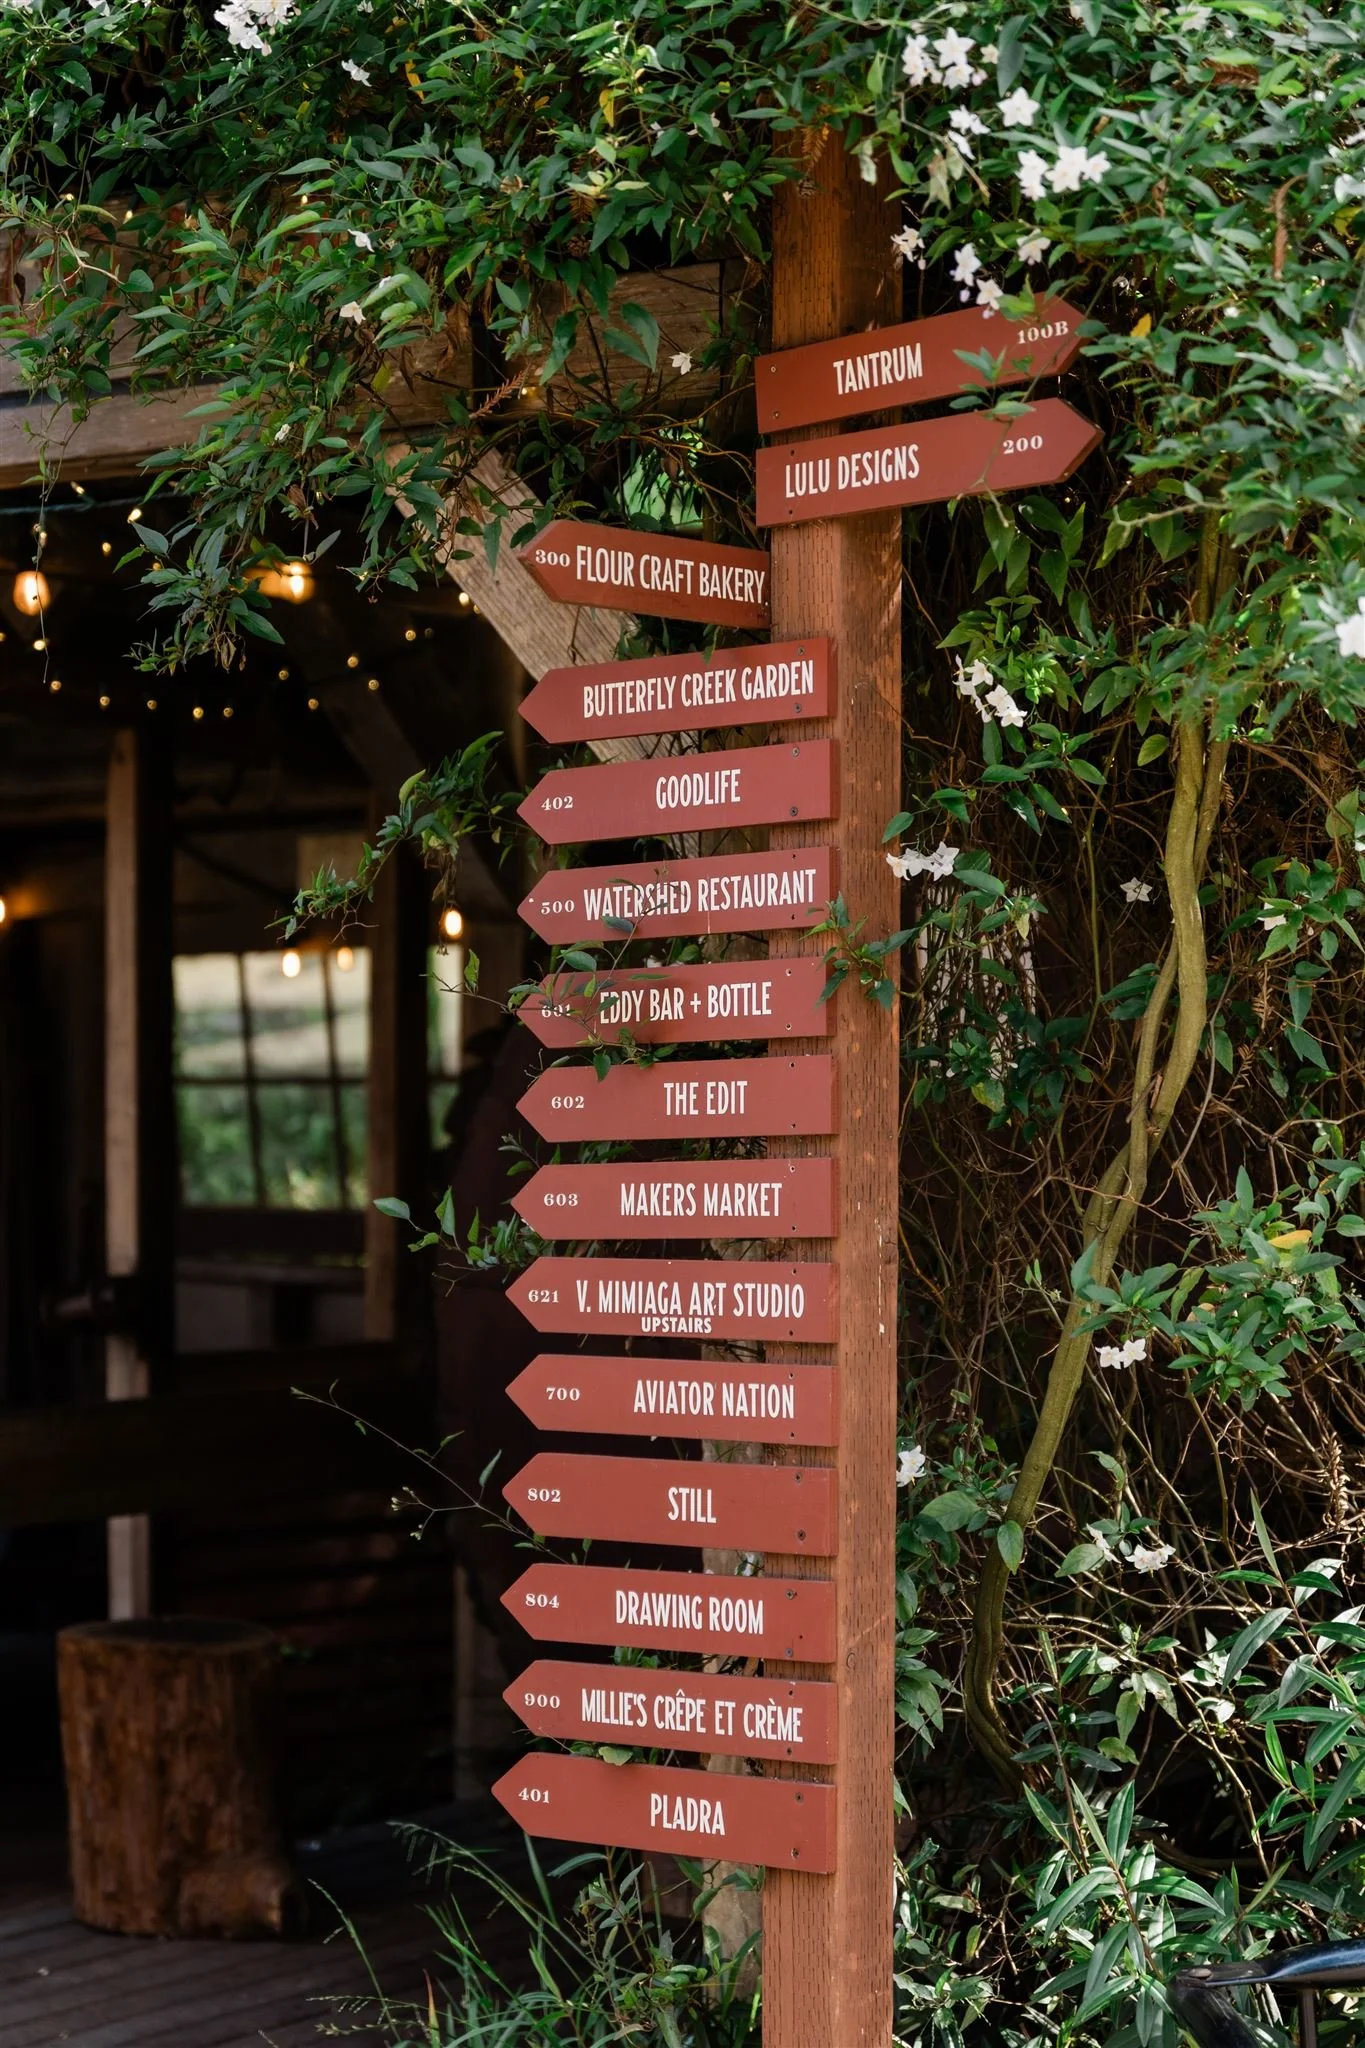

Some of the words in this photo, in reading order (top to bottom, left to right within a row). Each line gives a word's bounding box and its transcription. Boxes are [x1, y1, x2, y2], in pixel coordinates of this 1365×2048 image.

[833, 342, 923, 395] TANTRUM
[1018, 320, 1069, 344] 100B
[785, 458, 830, 498] LULU
[837, 443, 920, 490] DESIGNS
[1002, 435, 1043, 455] 200
[535, 549, 571, 567] 300
[576, 545, 635, 587] FLOUR
[639, 554, 695, 595] CRAFT
[699, 562, 765, 604] BAKERY
[583, 675, 677, 719] BUTTERFLY
[680, 668, 737, 708] CREEK
[741, 659, 814, 701] GARDEN
[540, 795, 574, 811] 402
[655, 768, 741, 810] GOODLIFE
[540, 899, 575, 915] 500
[583, 880, 692, 921] WATERSHED
[697, 868, 817, 912] RESTAURANT
[600, 989, 645, 1024] EDDY
[649, 987, 685, 1022] BAR
[689, 992, 702, 1014] +
[707, 981, 772, 1019] BOTTLE
[551, 1095, 585, 1109] 602
[663, 1081, 699, 1116] THE
[706, 1080, 748, 1115] EDIT
[543, 1193, 579, 1207] 603
[620, 1182, 697, 1217] MAKERS
[703, 1182, 783, 1217] MARKET
[528, 1289, 559, 1303] 621
[575, 1279, 592, 1313] V.
[598, 1279, 683, 1316] MIMIAGA
[688, 1281, 727, 1317] ART
[732, 1282, 805, 1319] STUDIO
[641, 1315, 712, 1334] UPSTAIRS
[546, 1386, 581, 1401] 700
[633, 1379, 715, 1416] AVIATOR
[721, 1381, 795, 1420] NATION
[527, 1487, 561, 1503] 802
[667, 1486, 717, 1524] STILL
[525, 1593, 560, 1609] 804
[615, 1589, 703, 1630] DRAWING
[708, 1596, 764, 1635] ROOM
[524, 1692, 561, 1709] 900
[581, 1687, 648, 1728] MILLIE'S
[653, 1688, 707, 1734] CRÊPE
[714, 1699, 737, 1736] ET
[743, 1697, 804, 1743] CRÈME
[518, 1787, 550, 1804] 401
[650, 1792, 726, 1836] PLADRA
